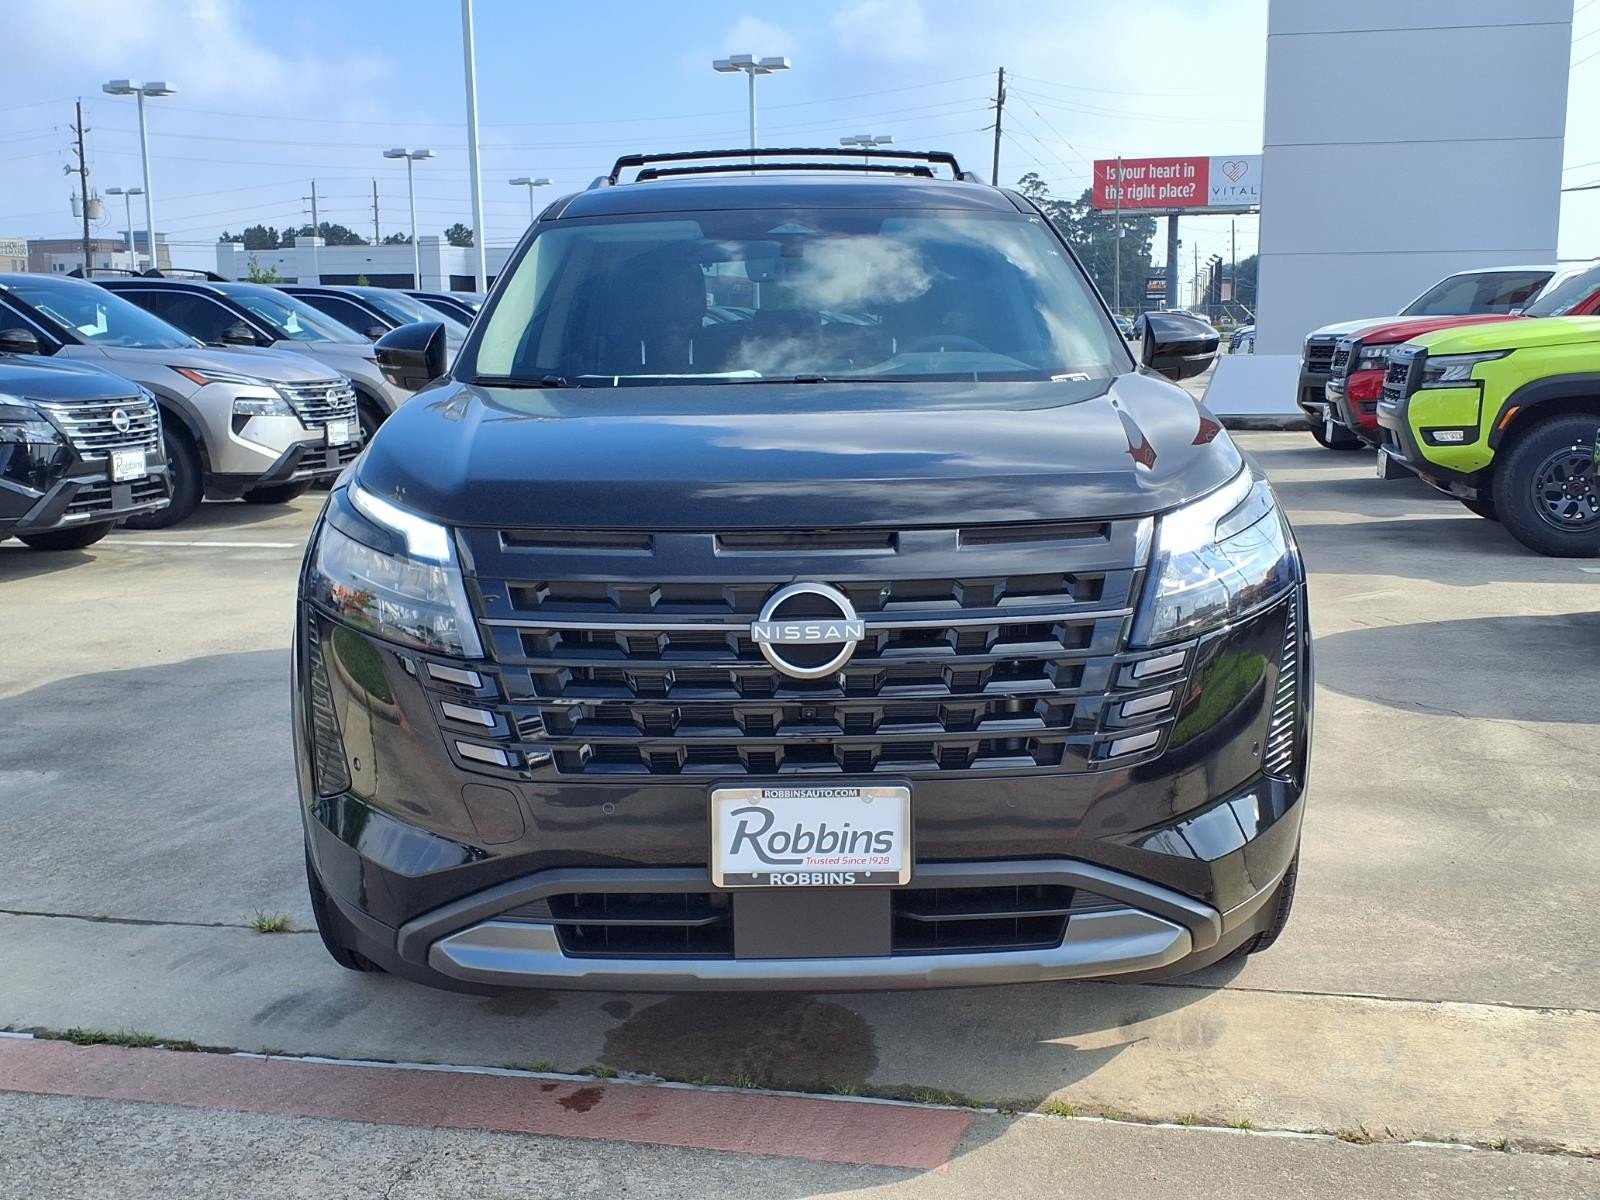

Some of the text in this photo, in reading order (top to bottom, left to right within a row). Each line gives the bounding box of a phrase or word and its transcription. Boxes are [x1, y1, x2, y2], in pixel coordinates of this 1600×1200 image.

[1106, 162, 1195, 182] Is your heart in
[1105, 182, 1196, 201] the right place?
[1212, 185, 1257, 196] VITAL
[754, 624, 861, 640] NISSAN
[764, 788, 858, 798] ROBBINSAUTO.COM
[729, 806, 894, 865] Robbins
[805, 856, 890, 865] Trusted Since 1928
[769, 872, 856, 885] ROBBINS
